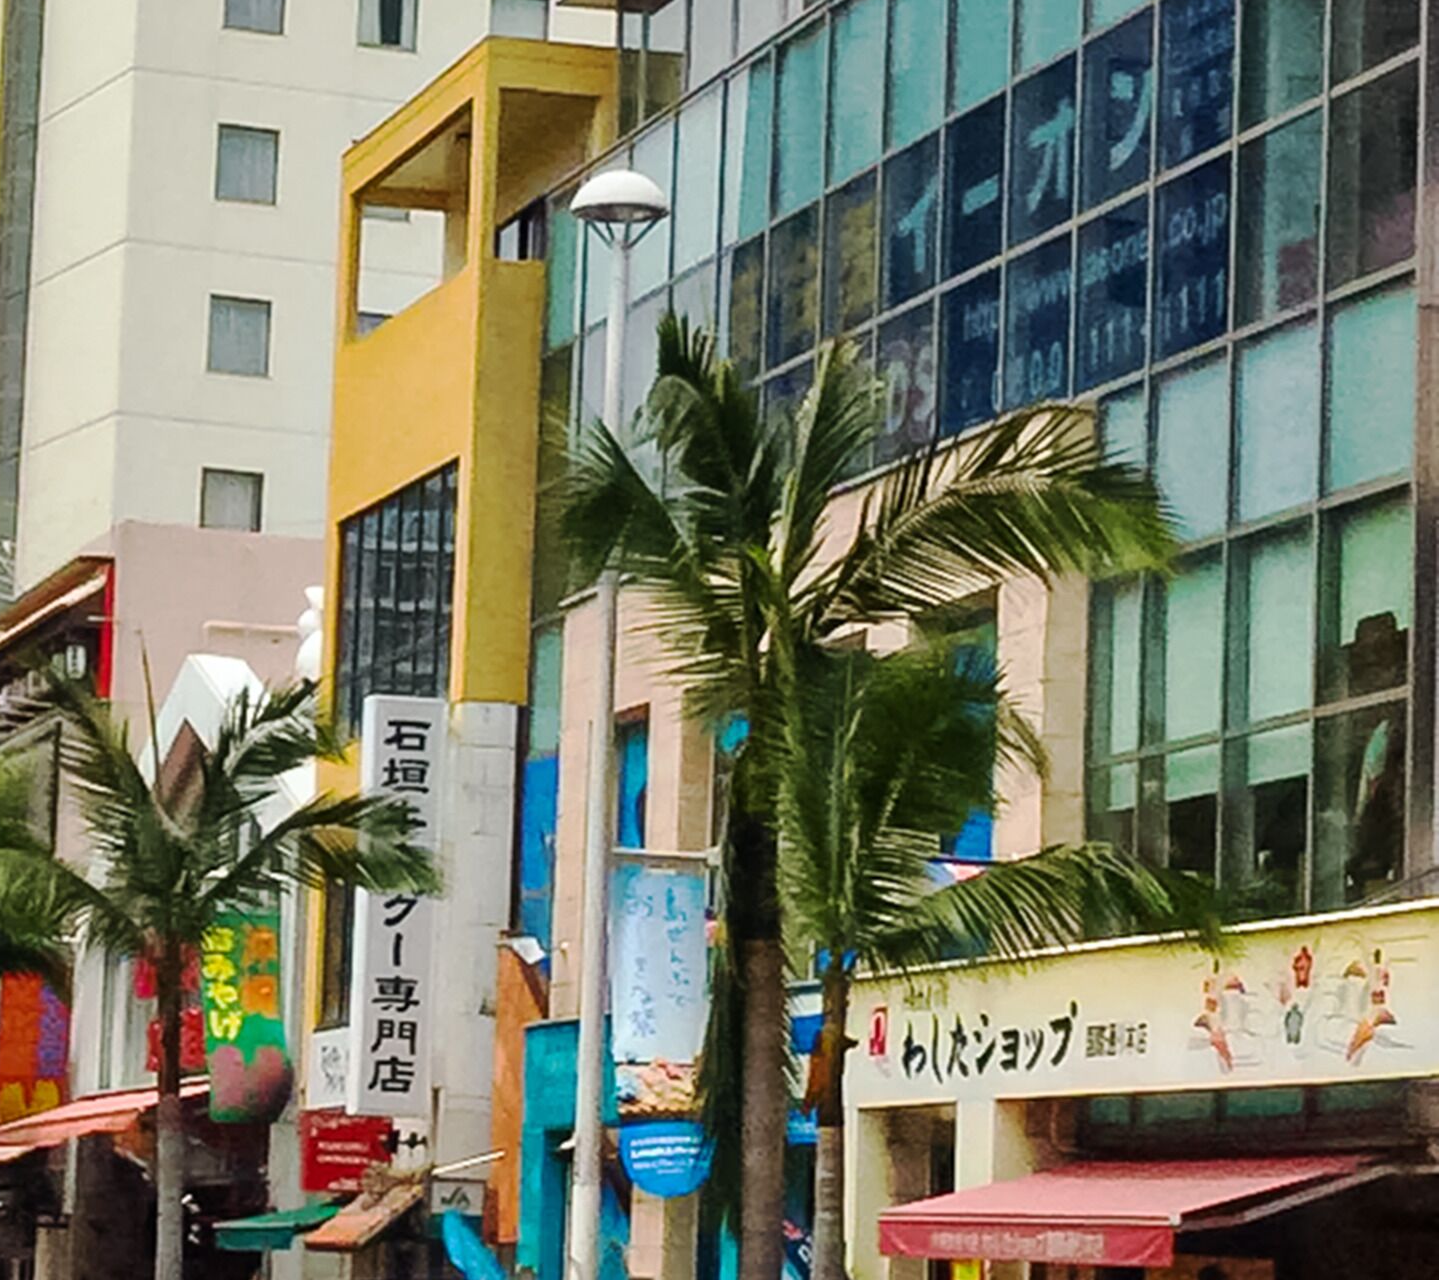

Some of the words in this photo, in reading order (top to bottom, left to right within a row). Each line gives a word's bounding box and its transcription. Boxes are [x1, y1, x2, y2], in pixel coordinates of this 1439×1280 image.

[902, 1000, 1078, 1084] わしたショップ
